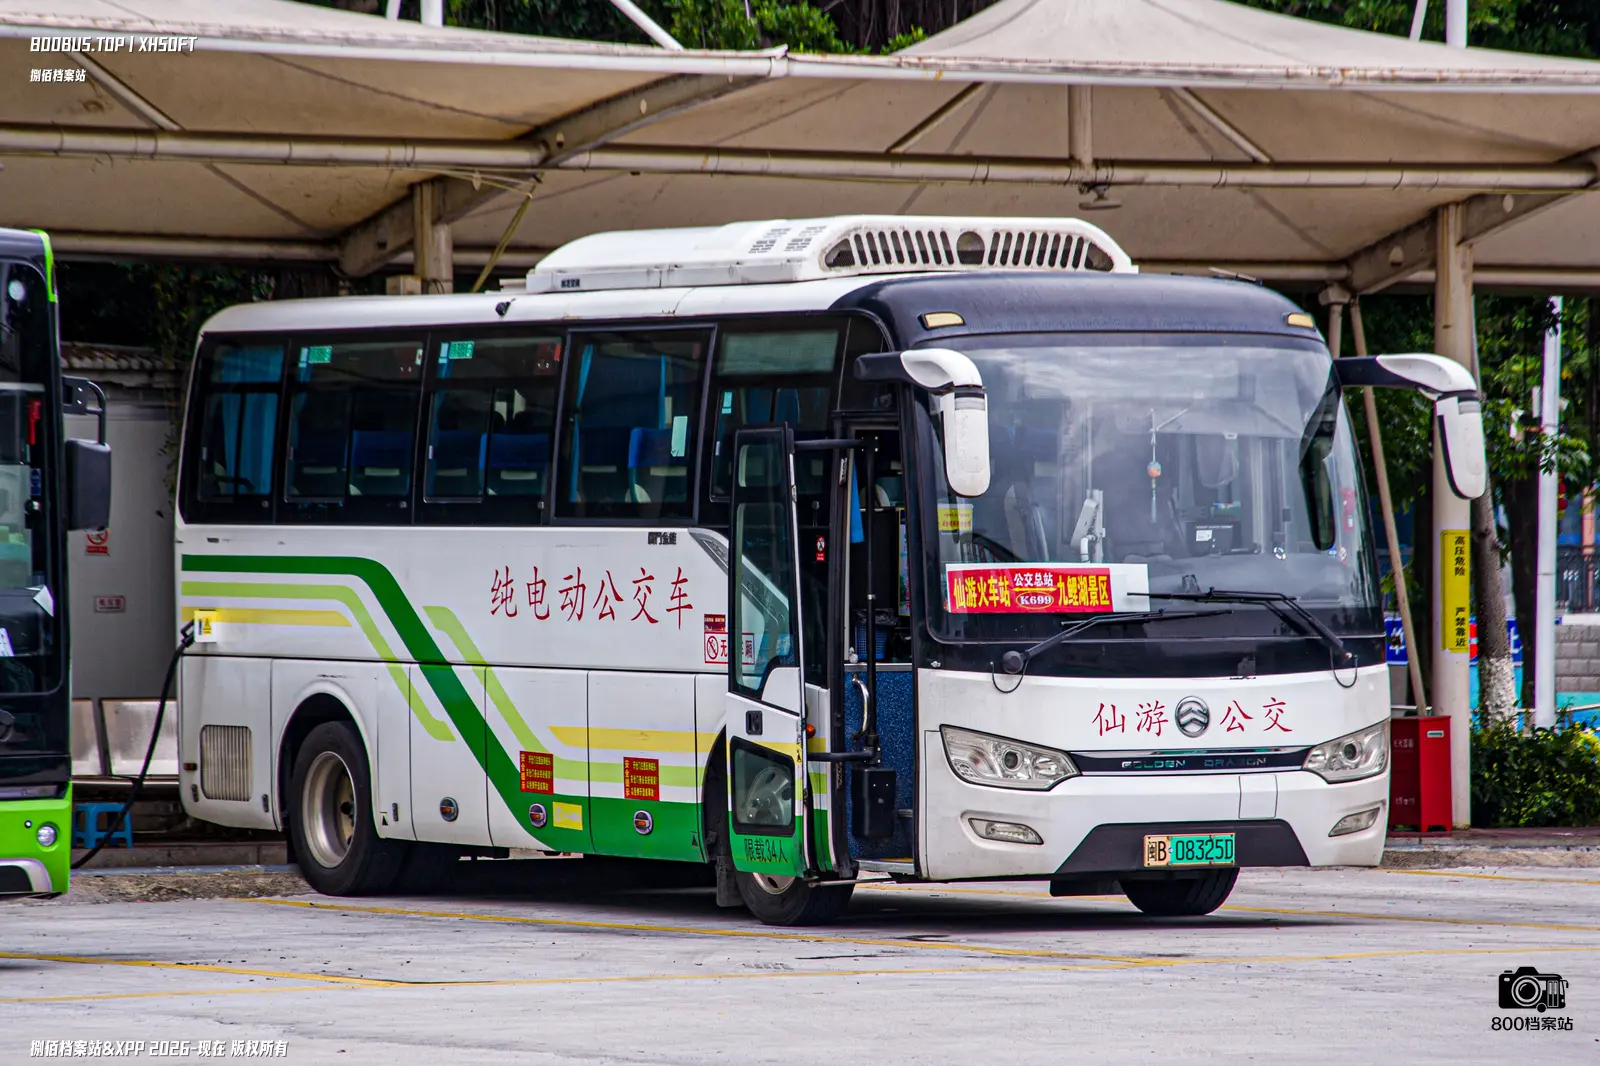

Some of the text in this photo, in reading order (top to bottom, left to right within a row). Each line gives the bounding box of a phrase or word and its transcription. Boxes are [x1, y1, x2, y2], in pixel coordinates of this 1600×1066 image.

[1454, 535, 1466, 576] 高压危险
[953, 575, 1012, 609] 仙游火车站
[1013, 572, 1054, 587] 公交总站
[1057, 575, 1110, 607] 九鲤湖景区
[490, 565, 693, 630] 纯电动公交车
[1020, 595, 1053, 605] K699
[1455, 606, 1466, 647] 严禁靠近
[1092, 697, 1293, 737] 仙游 公交
[1204, 757, 1267, 767] DRAON
[743, 837, 789, 864] 限载34人
[1175, 838, 1234, 861] 08325D
